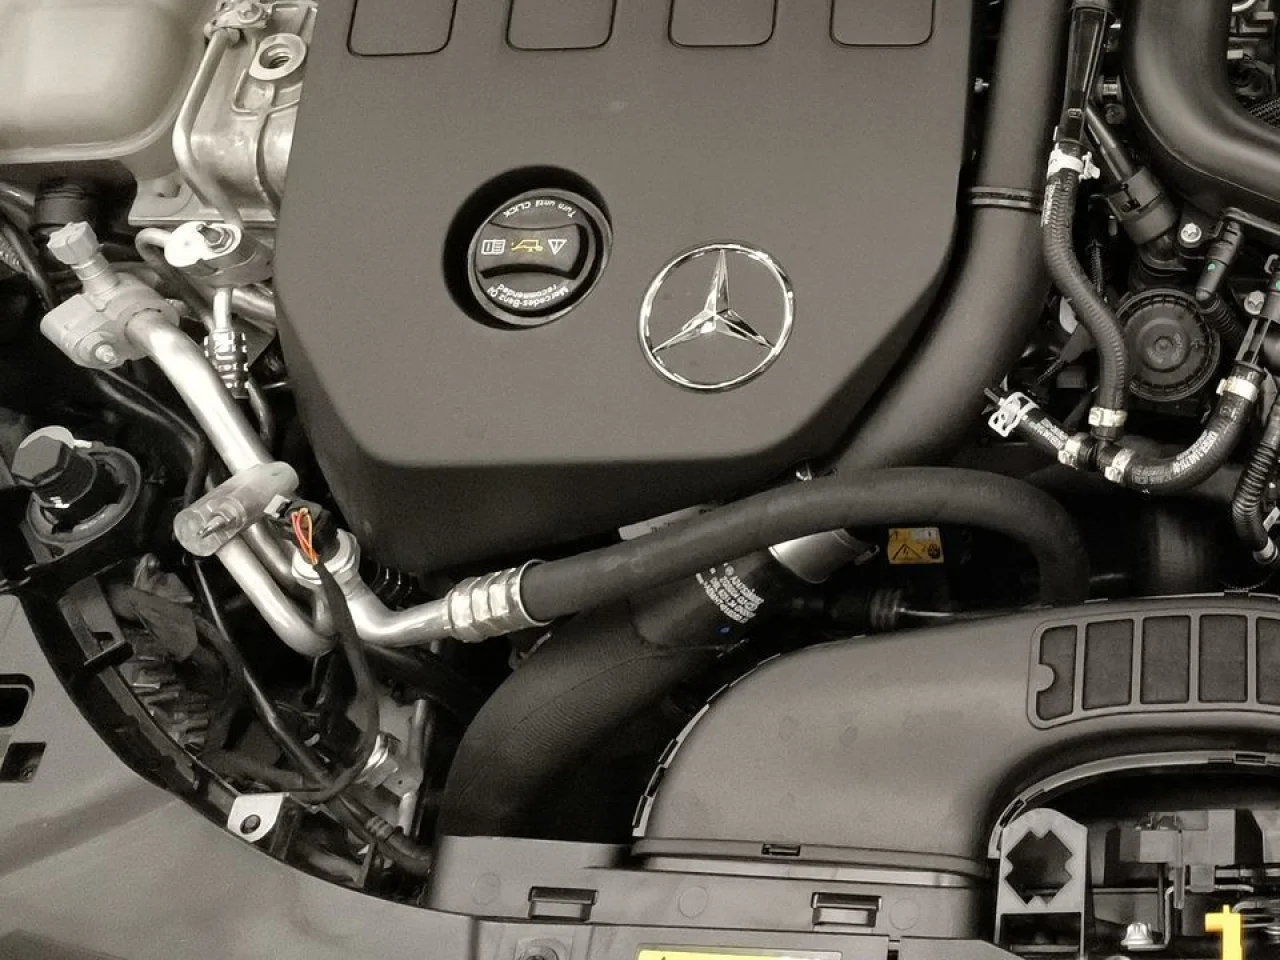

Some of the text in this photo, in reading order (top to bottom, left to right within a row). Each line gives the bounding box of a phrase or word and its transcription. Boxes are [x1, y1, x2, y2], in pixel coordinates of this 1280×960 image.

[503, 201, 531, 218] CLICK
[558, 203, 576, 218] Turn
[497, 283, 557, 299] recommended
[498, 286, 569, 308] Mercedes-Benz
